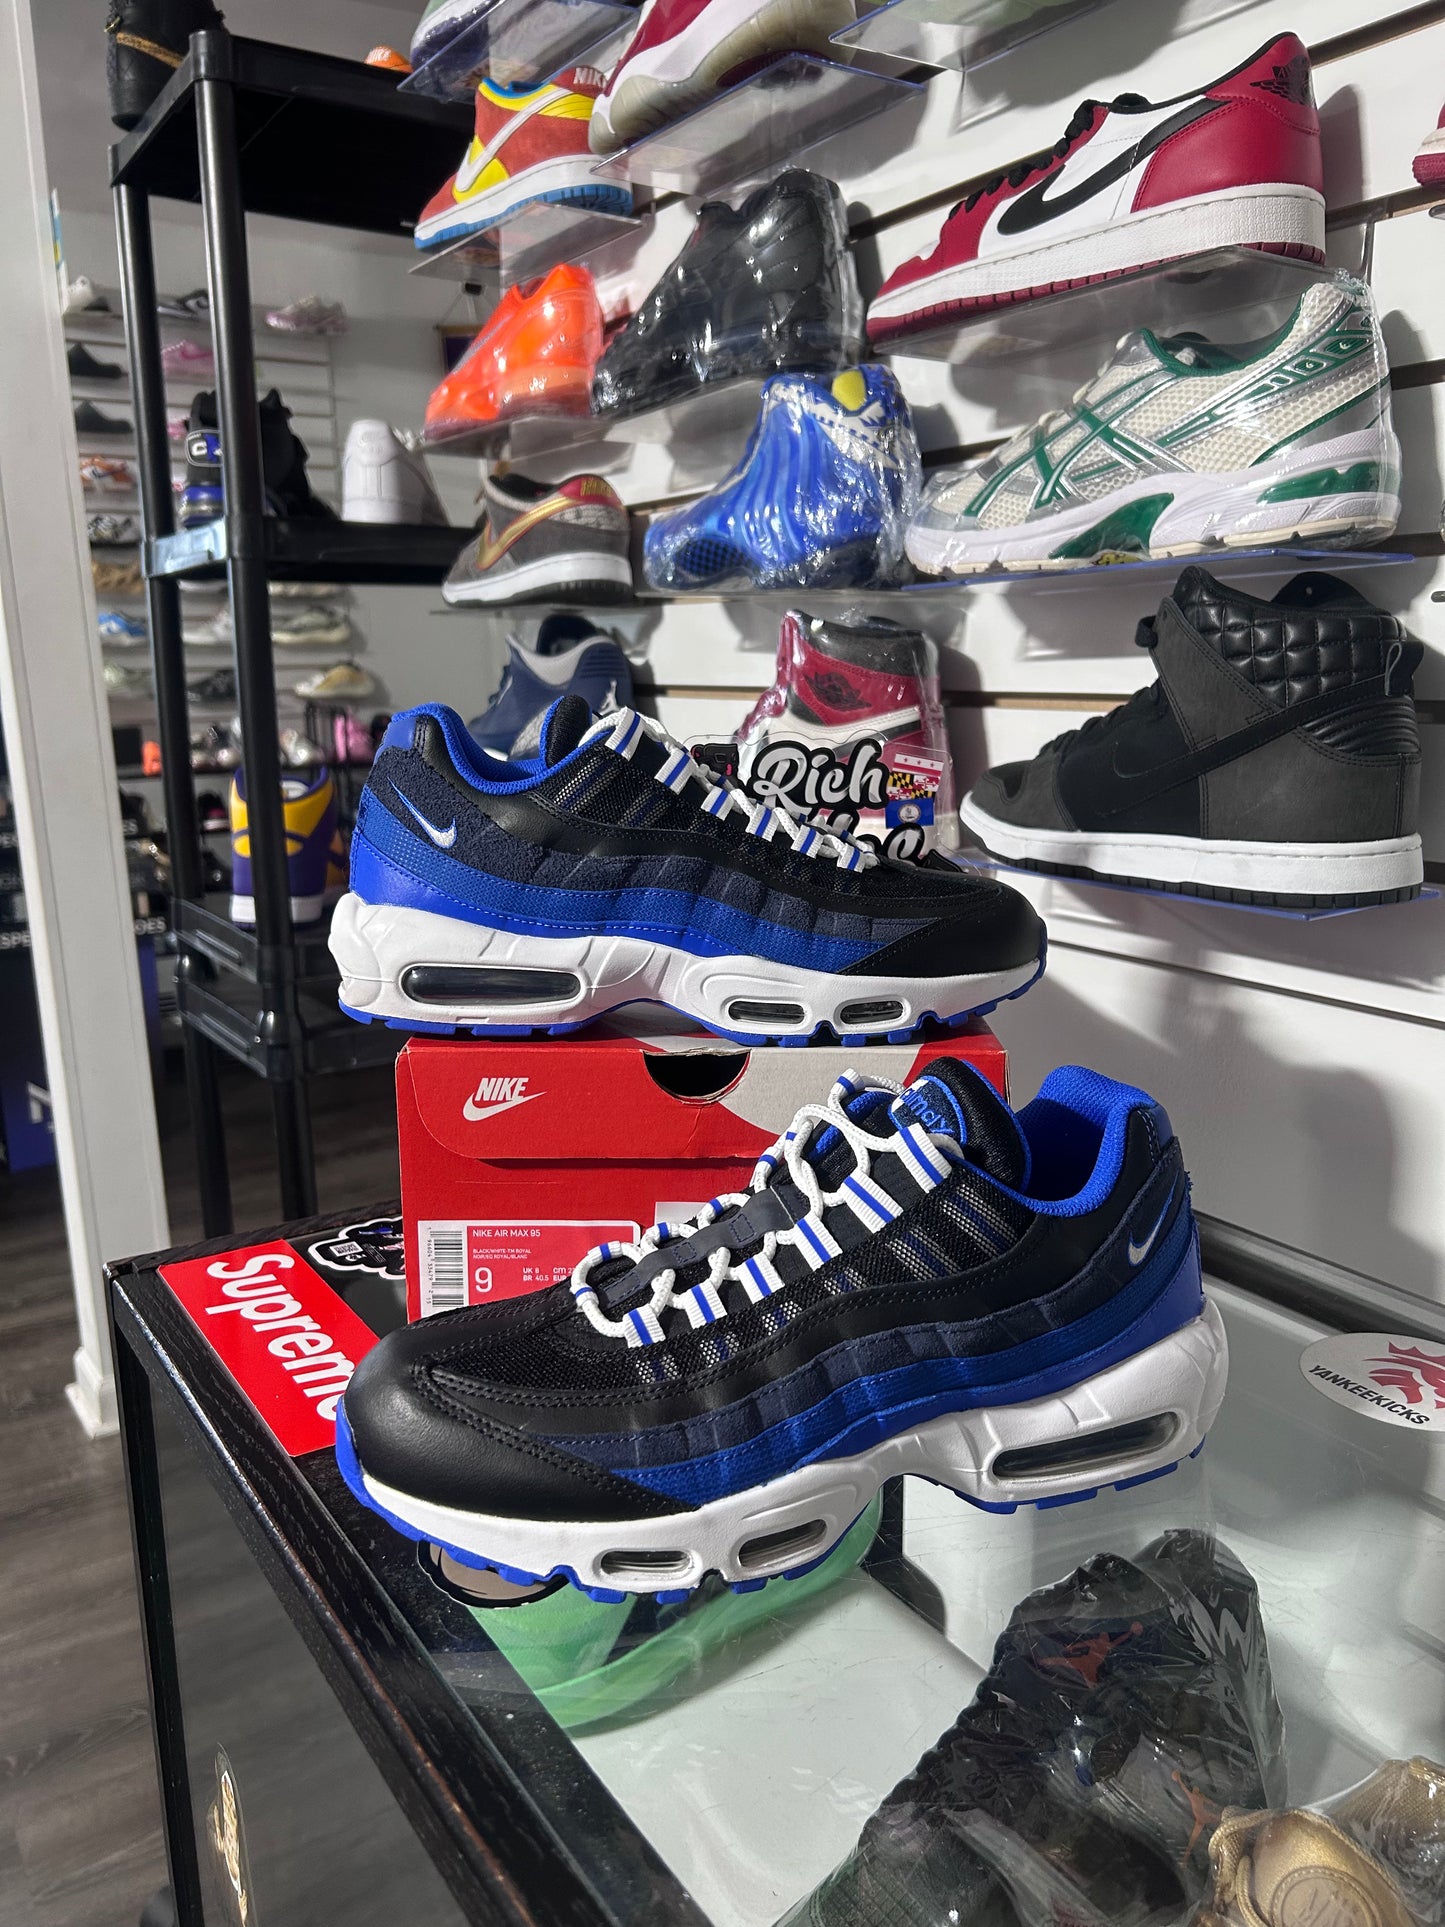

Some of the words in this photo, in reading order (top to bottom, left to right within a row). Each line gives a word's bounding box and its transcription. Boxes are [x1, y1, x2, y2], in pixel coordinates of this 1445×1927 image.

[753, 744, 884, 817] Rich
[474, 1077, 529, 1101] NIKE
[472, 1229, 492, 1237] NIKE
[494, 1229, 508, 1237] AIR
[510, 1229, 528, 1237] MAX
[530, 1229, 541, 1237] 95
[475, 1266, 493, 1293] 9
[1308, 1365, 1431, 1425] YANKEEKICKS
